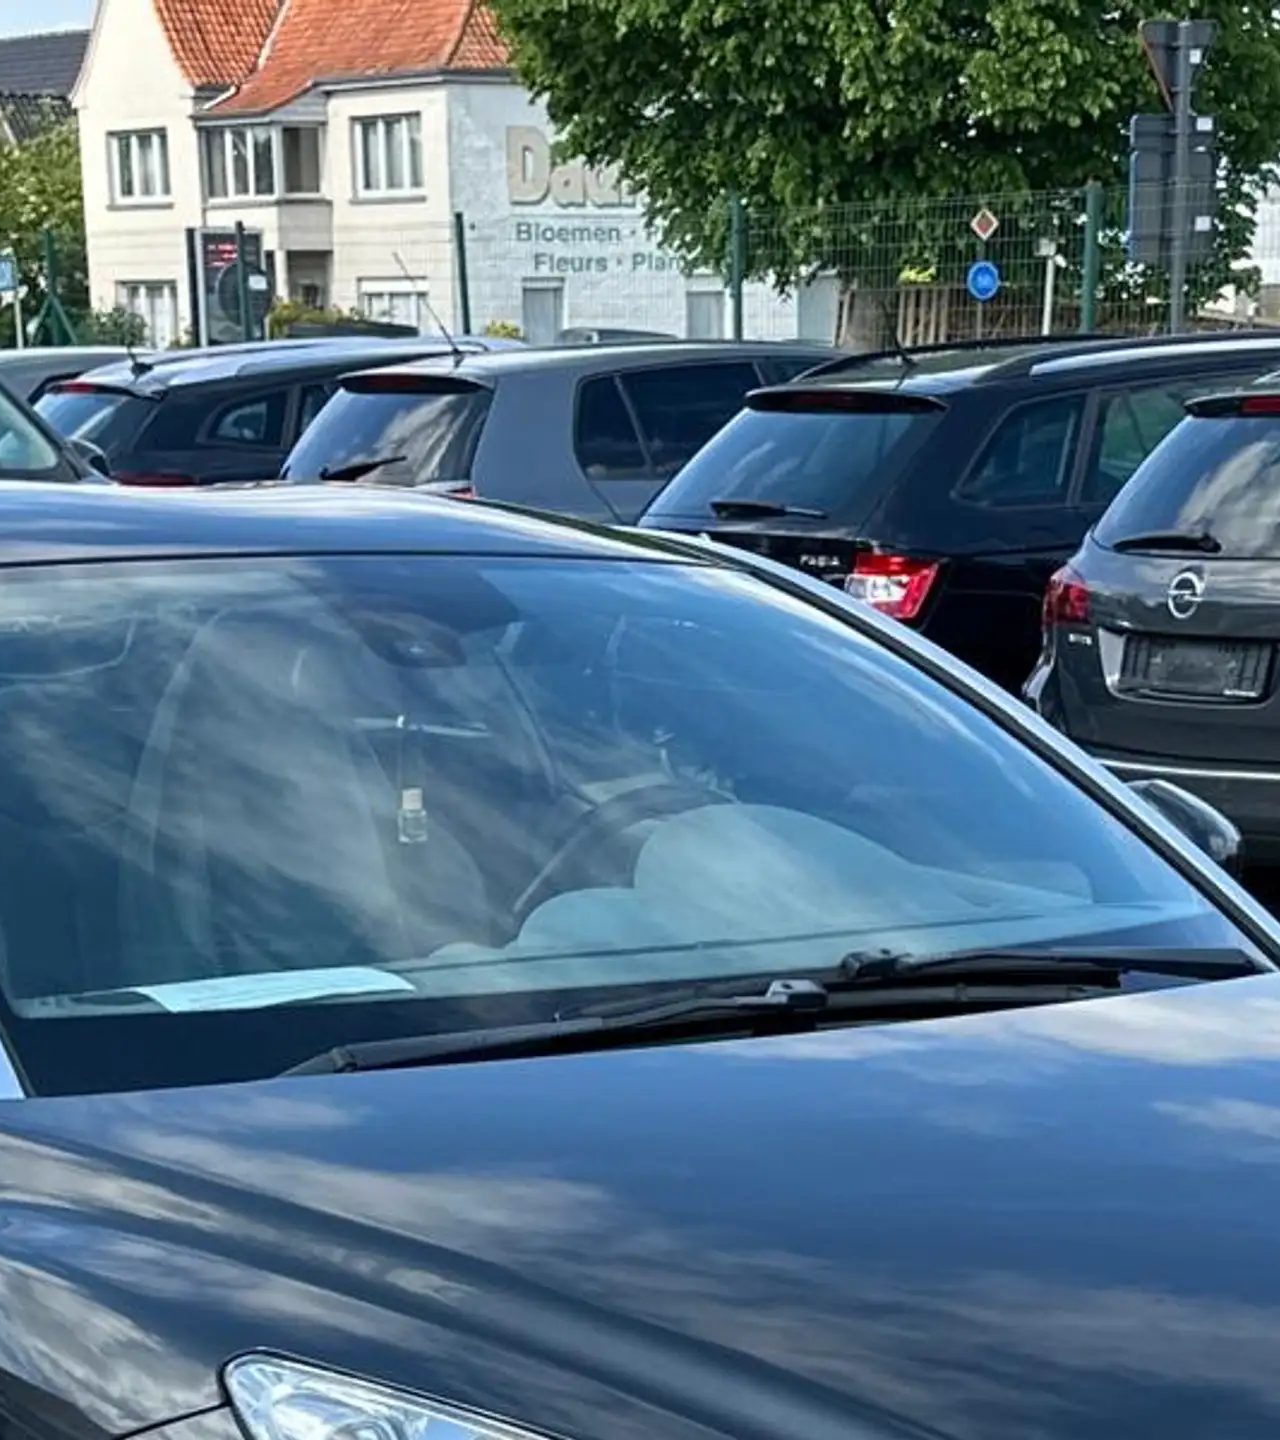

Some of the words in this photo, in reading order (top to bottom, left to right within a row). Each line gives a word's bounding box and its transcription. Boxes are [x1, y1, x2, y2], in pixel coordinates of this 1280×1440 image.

[516, 222, 620, 242] Bloemen
[534, 252, 608, 273] Fleurs
[632, 252, 681, 272] Plan
